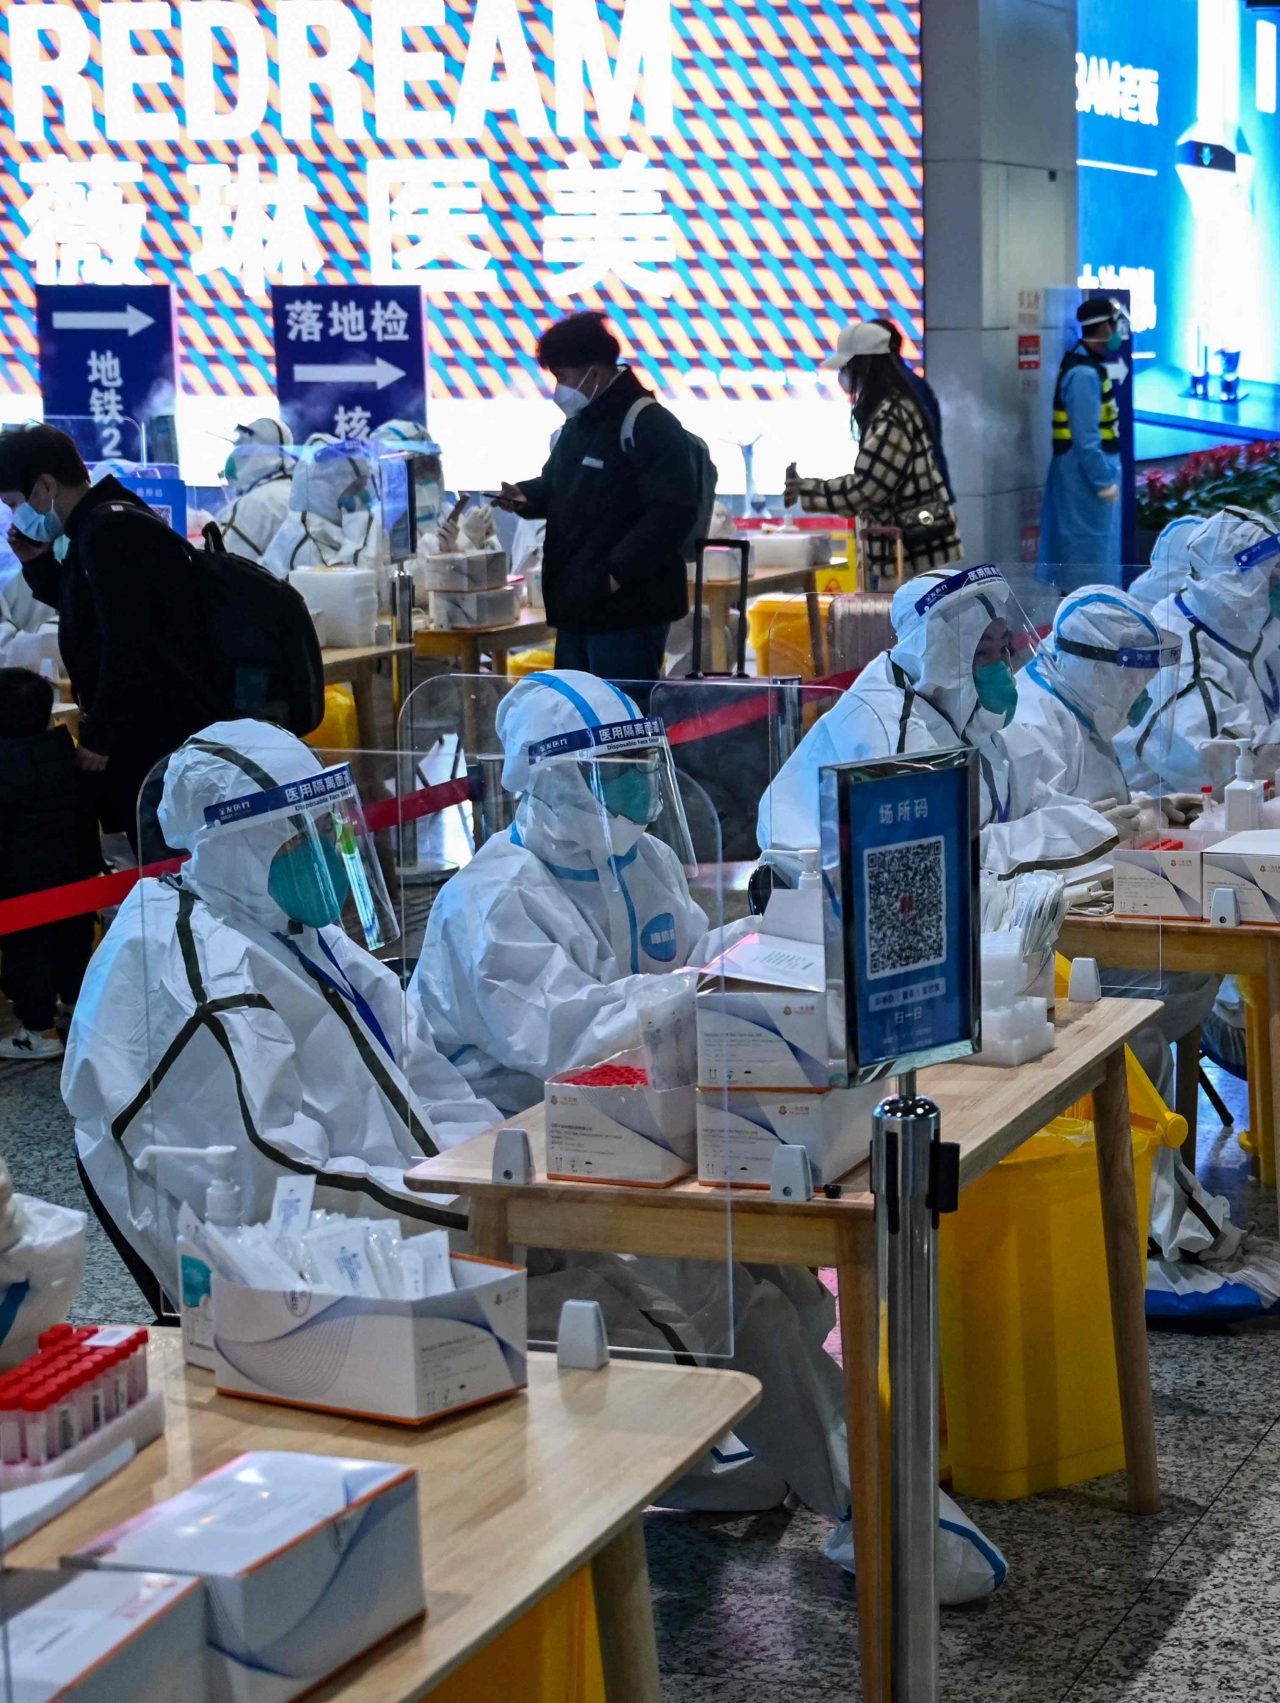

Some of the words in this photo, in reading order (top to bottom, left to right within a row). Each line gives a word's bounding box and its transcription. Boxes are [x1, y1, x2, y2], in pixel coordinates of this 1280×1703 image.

[9, 0, 674, 142] REDREAM
[18, 150, 678, 298] 薇琳医美
[285, 300, 410, 342] 落地检
[333, 406, 373, 439] 核
[879, 797, 929, 825] 场所码
